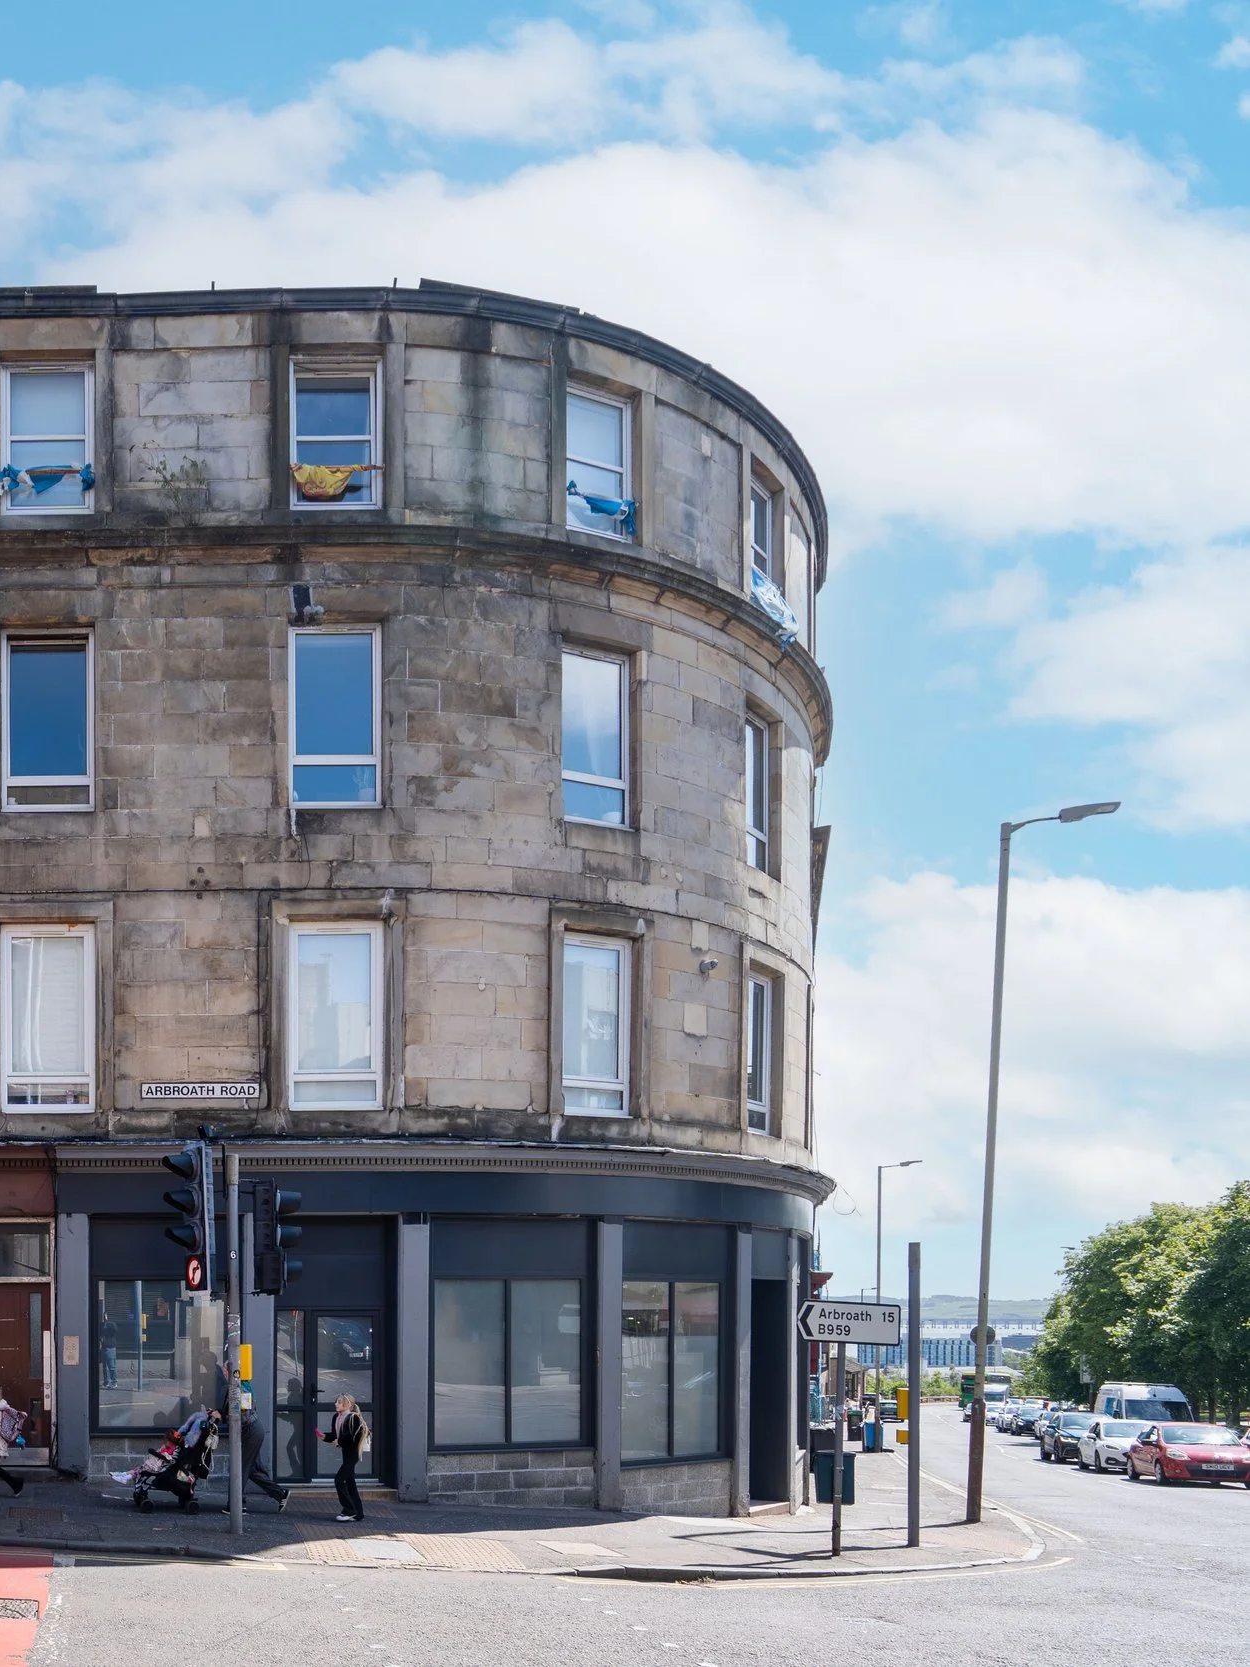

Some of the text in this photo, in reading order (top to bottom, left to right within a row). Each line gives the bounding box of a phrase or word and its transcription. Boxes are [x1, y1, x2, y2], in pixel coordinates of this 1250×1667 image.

[145, 1085, 256, 1096] ARBROATH ROAD
[230, 1250, 237, 1259] 6
[818, 1308, 895, 1323] Arbroath 15
[818, 1323, 851, 1336] B959
